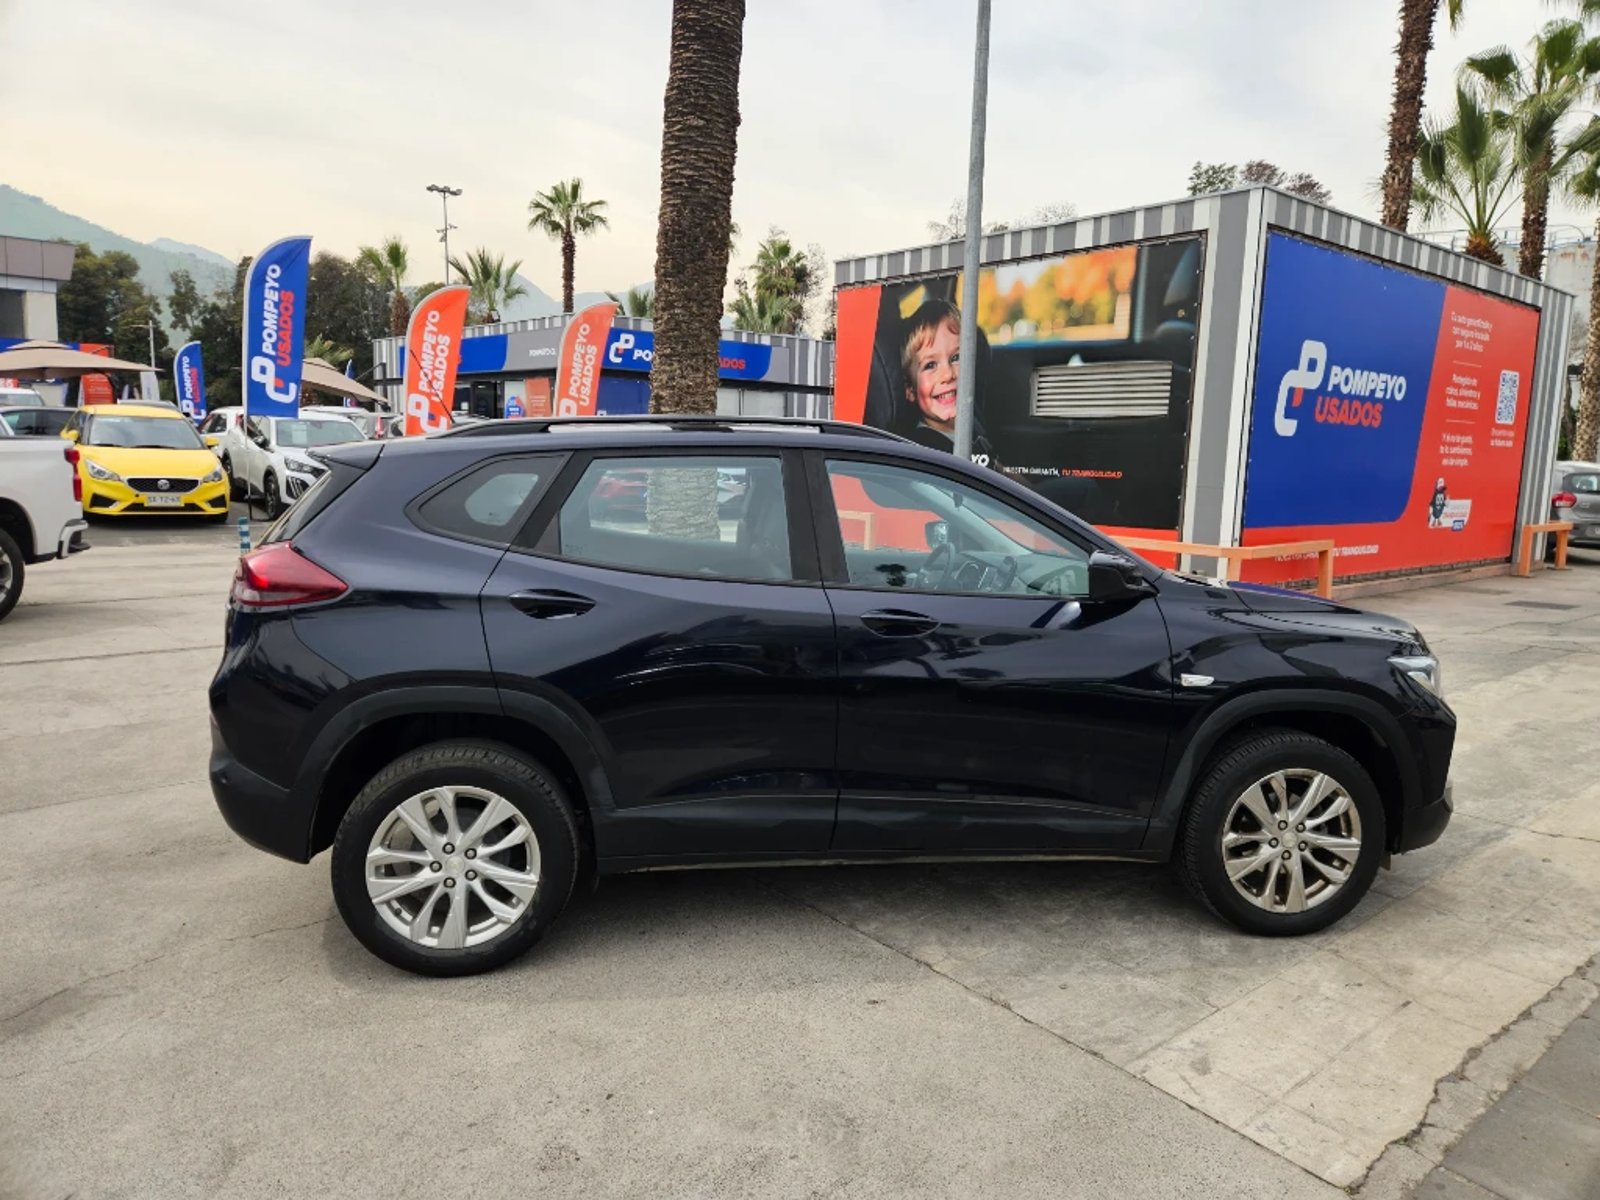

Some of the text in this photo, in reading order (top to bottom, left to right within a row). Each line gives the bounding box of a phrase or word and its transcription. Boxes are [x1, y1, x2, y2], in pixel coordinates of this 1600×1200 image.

[262, 264, 281, 355] POMPEYO
[277, 290, 294, 366] USADOS
[418, 310, 440, 393] POMPEYO
[430, 334, 451, 402] USADOS
[568, 323, 590, 398] POMPEYO
[579, 344, 597, 406] USADOS
[1327, 365, 1407, 401] POMPEYO
[1315, 396, 1383, 428] USADOS
